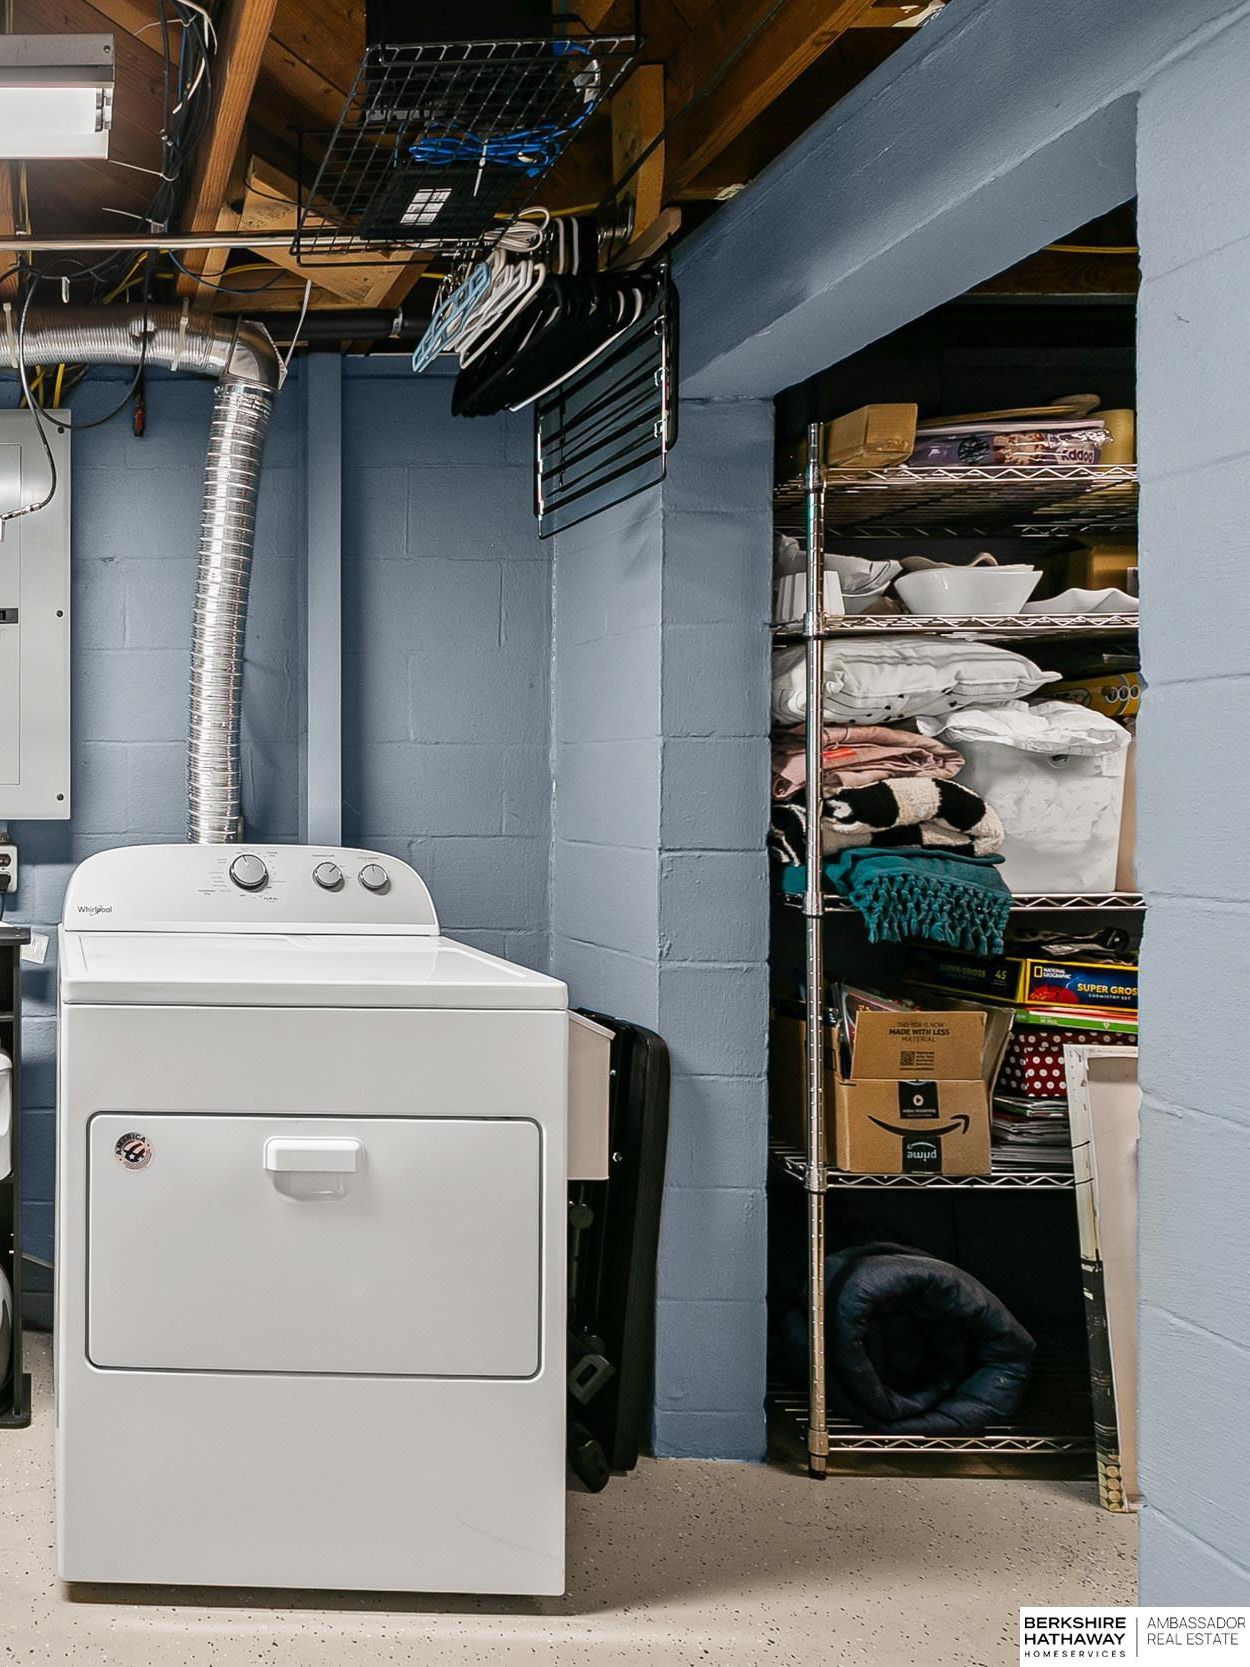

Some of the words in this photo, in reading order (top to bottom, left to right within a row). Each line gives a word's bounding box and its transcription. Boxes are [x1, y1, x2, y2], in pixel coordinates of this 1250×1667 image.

[77, 904, 113, 917] Whirlpool
[1077, 983, 1108, 994] SUPER
[888, 1028, 911, 1036] MADE
[911, 1028, 932, 1036] WITH
[932, 1028, 951, 1036] LESS
[906, 1149, 938, 1162] prime
